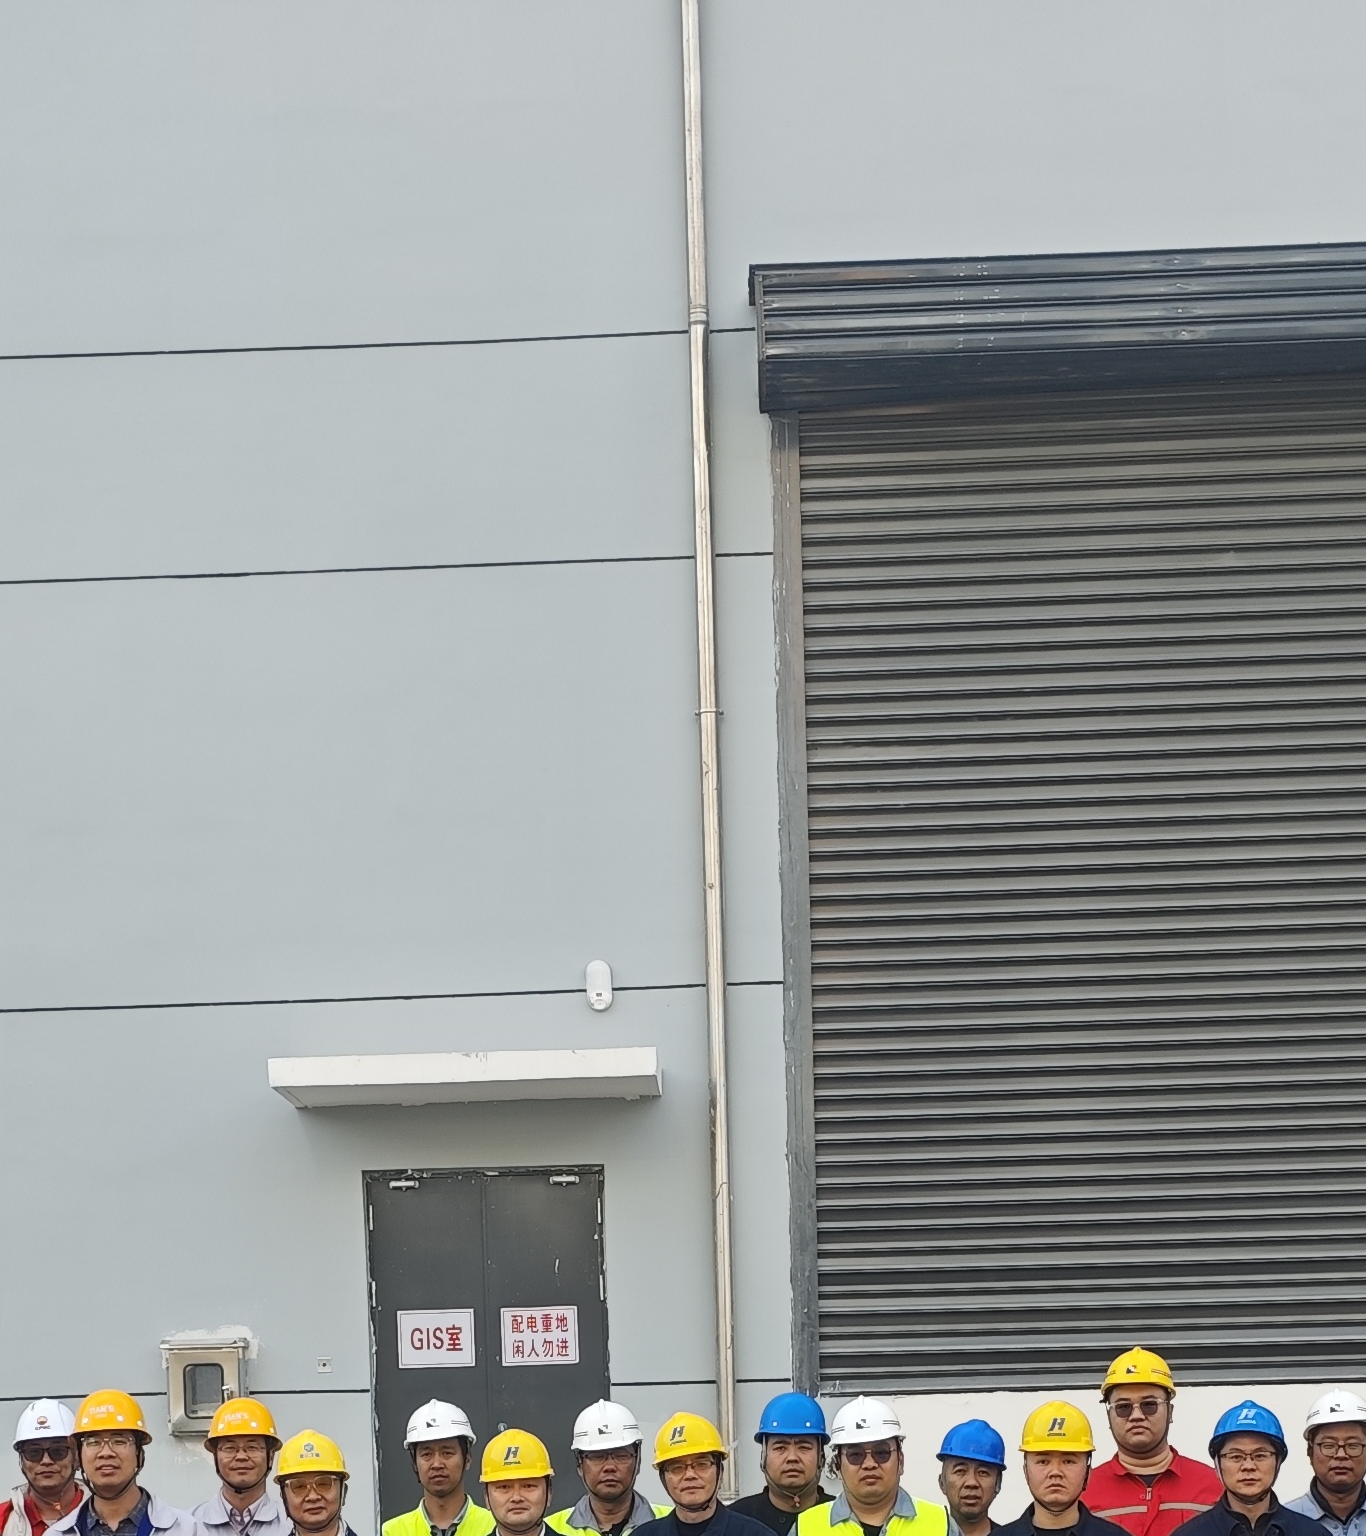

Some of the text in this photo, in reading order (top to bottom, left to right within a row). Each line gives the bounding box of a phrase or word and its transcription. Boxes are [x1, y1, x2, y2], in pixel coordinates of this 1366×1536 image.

[510, 1312, 569, 1334] 配电重地
[410, 1324, 463, 1352] GIS室
[512, 1337, 570, 1359] 闲人勿进
